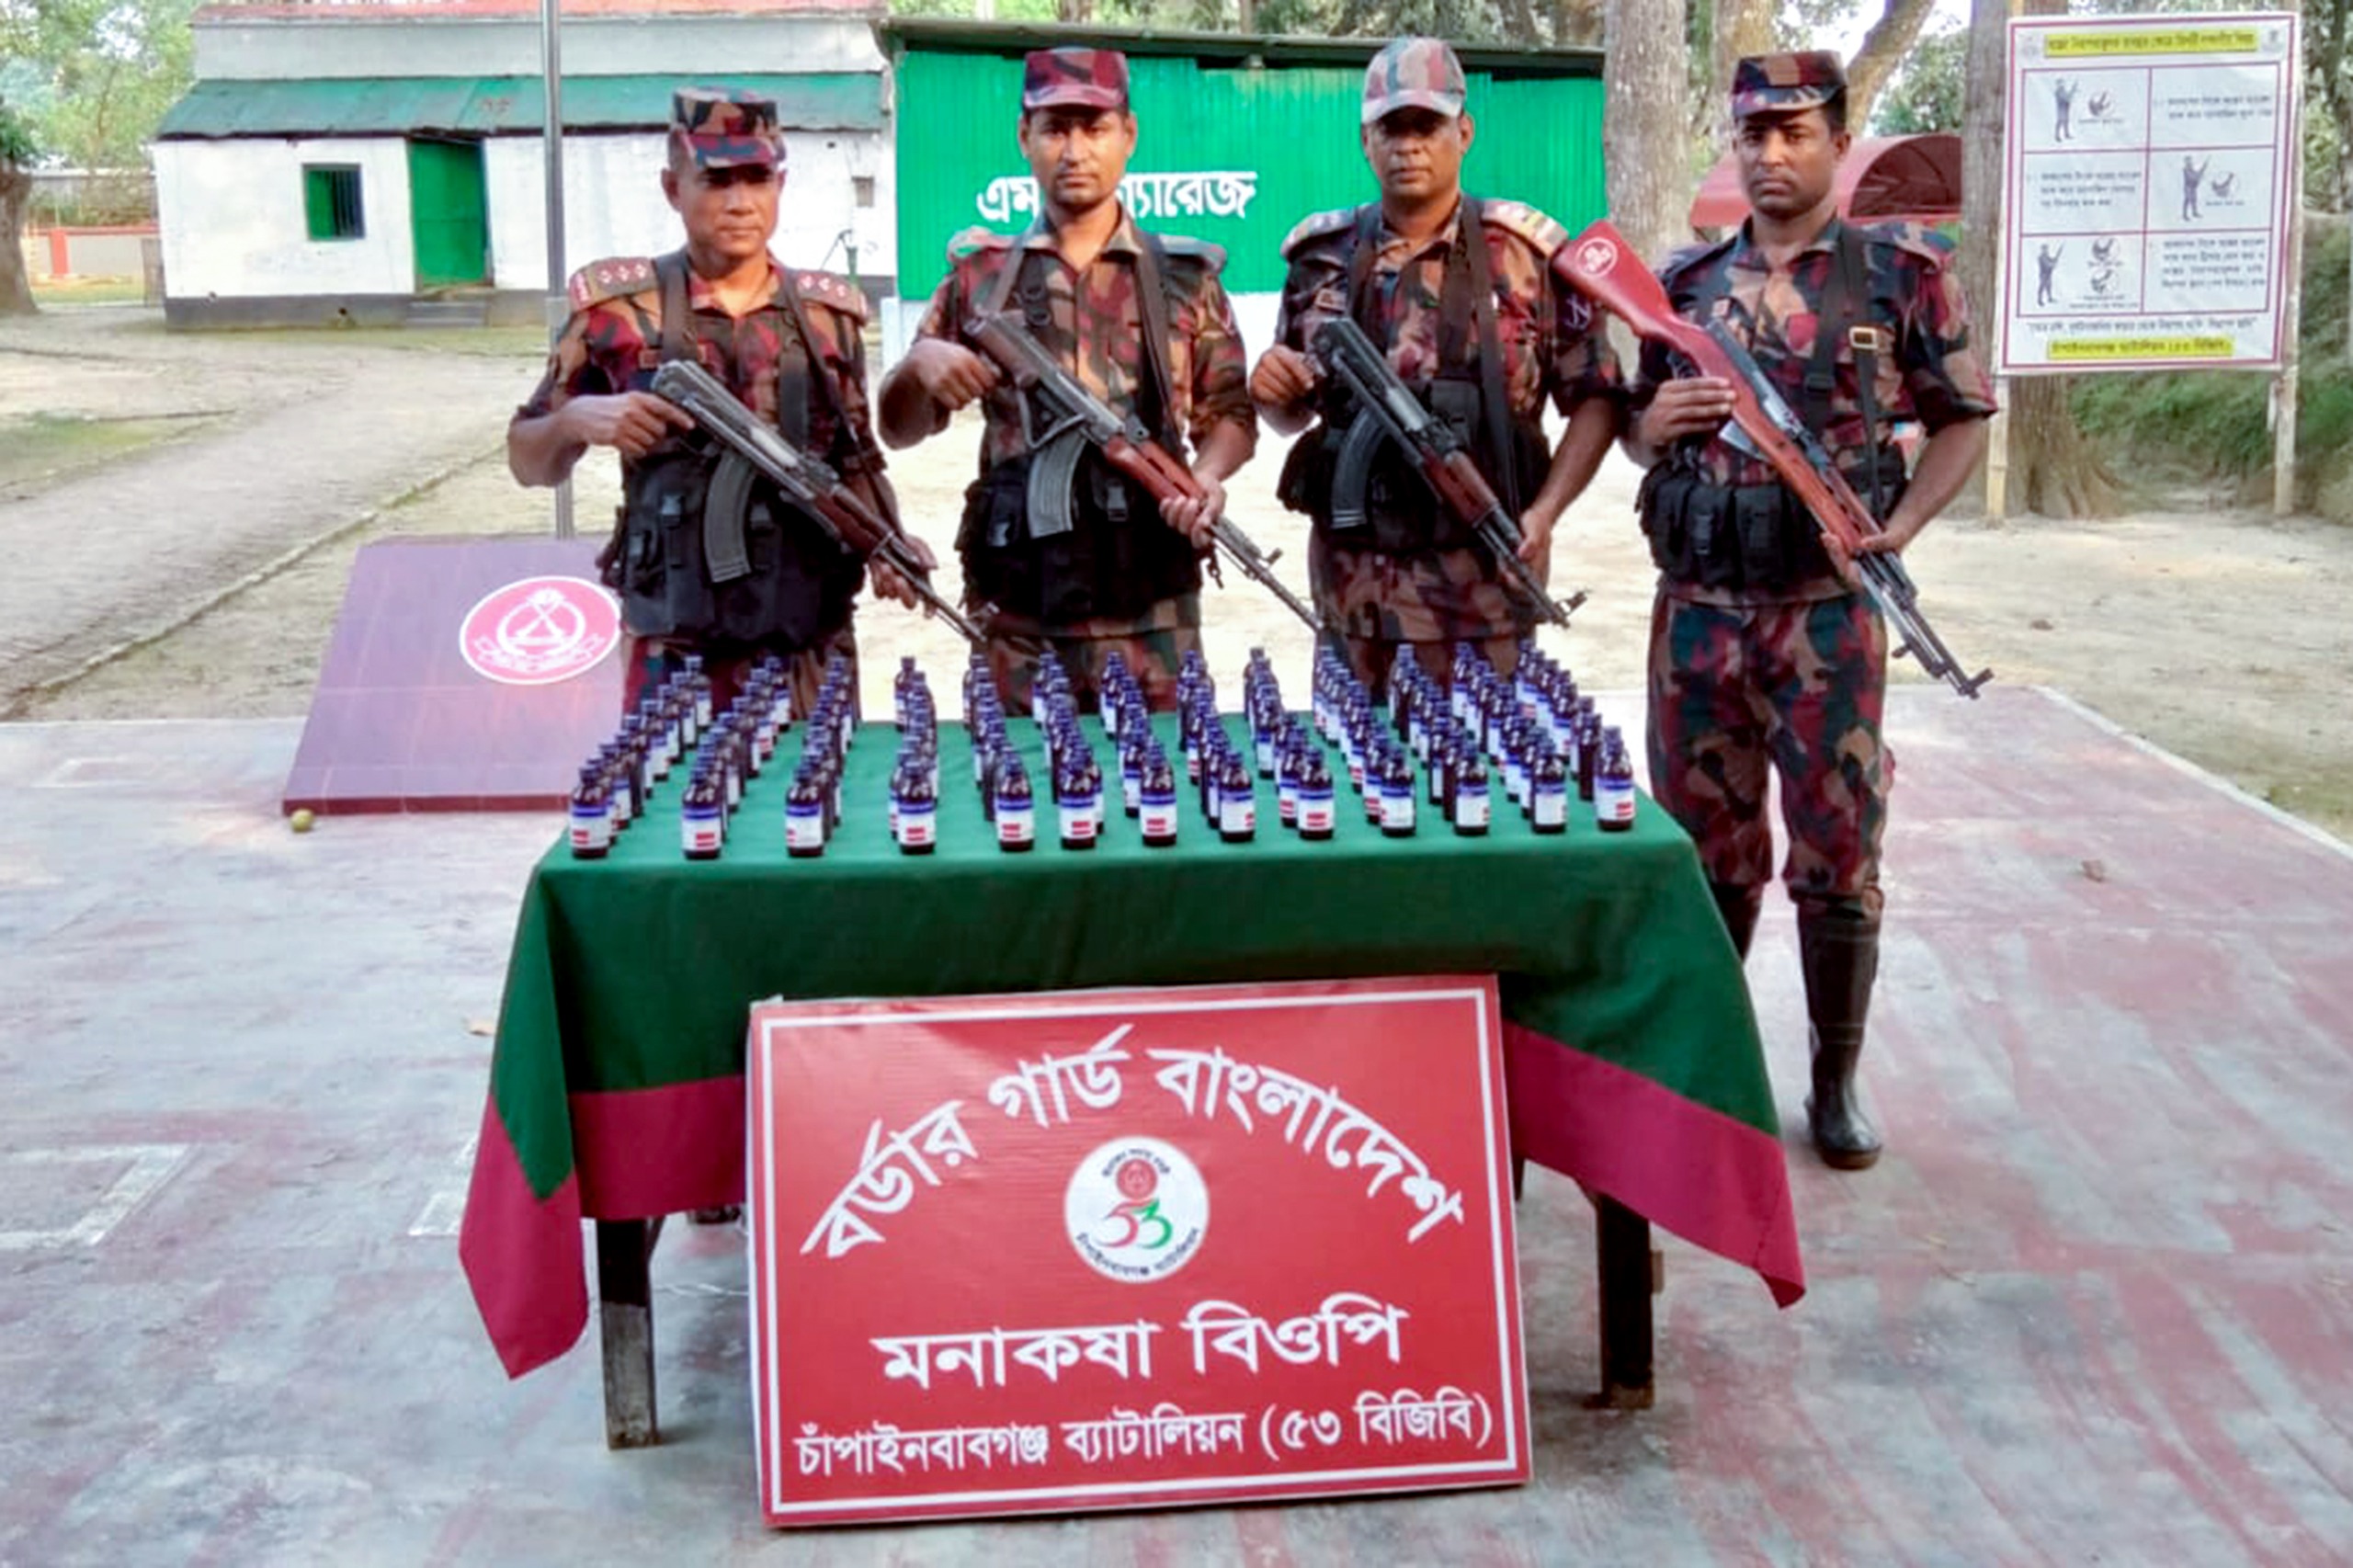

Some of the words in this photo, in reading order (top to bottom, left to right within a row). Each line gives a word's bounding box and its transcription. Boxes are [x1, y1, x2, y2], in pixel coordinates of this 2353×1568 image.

[800, 1098, 979, 1258] বর্ডার
[987, 1023, 1133, 1129] গার্ড
[1147, 1046, 1464, 1243] বাংলাদেশ
[870, 1318, 1162, 1390] মনাকষা
[1179, 1292, 1409, 1375] বিওপি
[1061, 1402, 1246, 1461] ব্যাটালিয়ন
